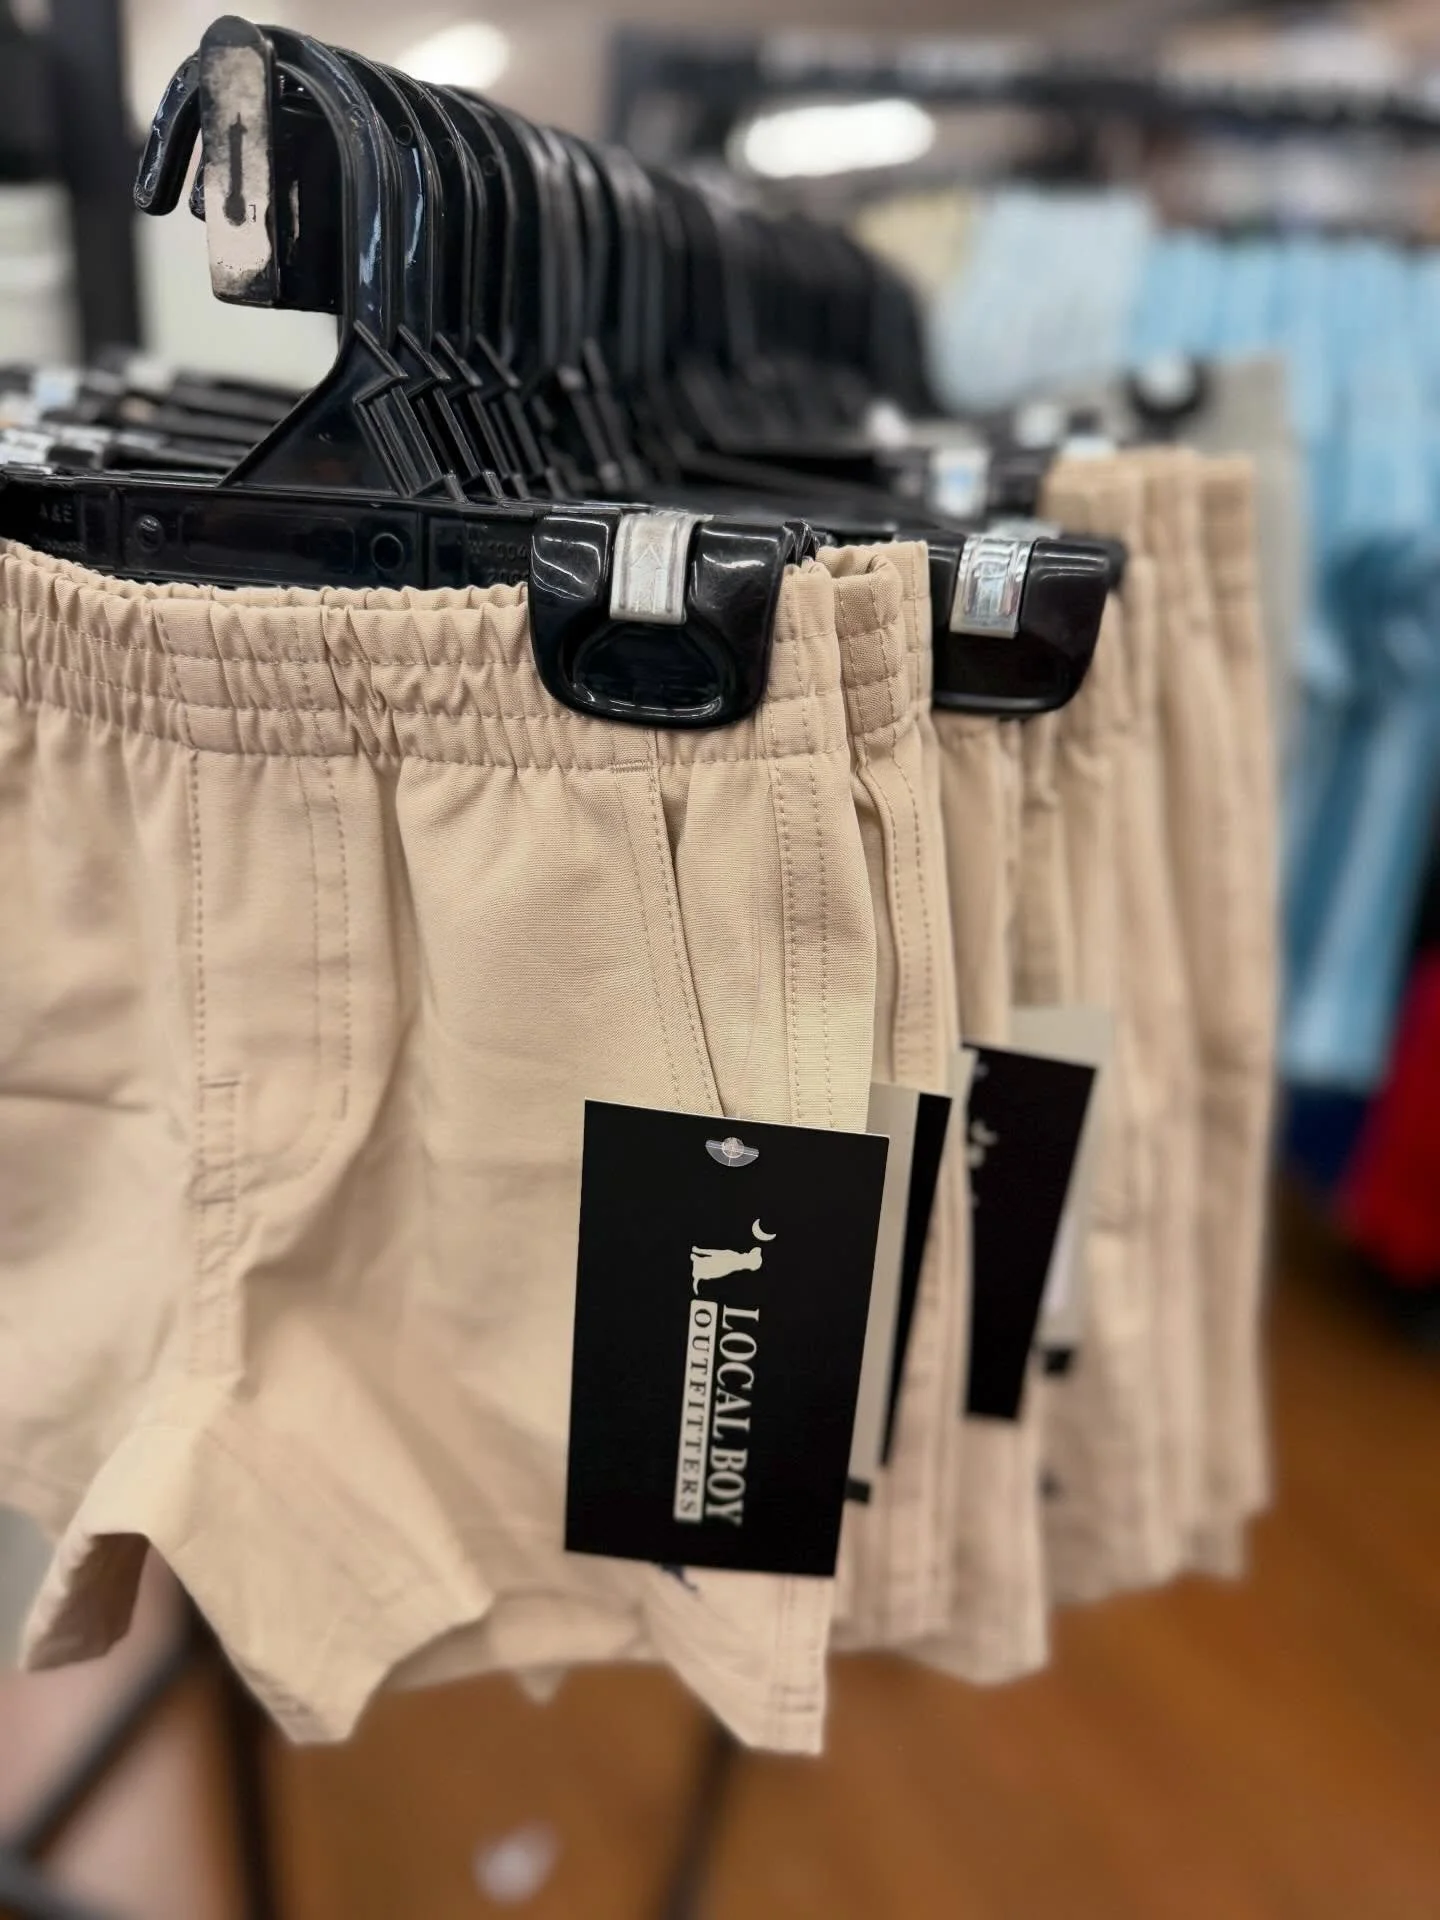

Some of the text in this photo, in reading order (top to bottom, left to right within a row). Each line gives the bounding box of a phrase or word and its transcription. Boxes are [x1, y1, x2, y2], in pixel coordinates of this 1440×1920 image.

[679, 1307, 713, 1514] OUTFITTERS
[706, 1304, 760, 1526] LOCAL BOY
